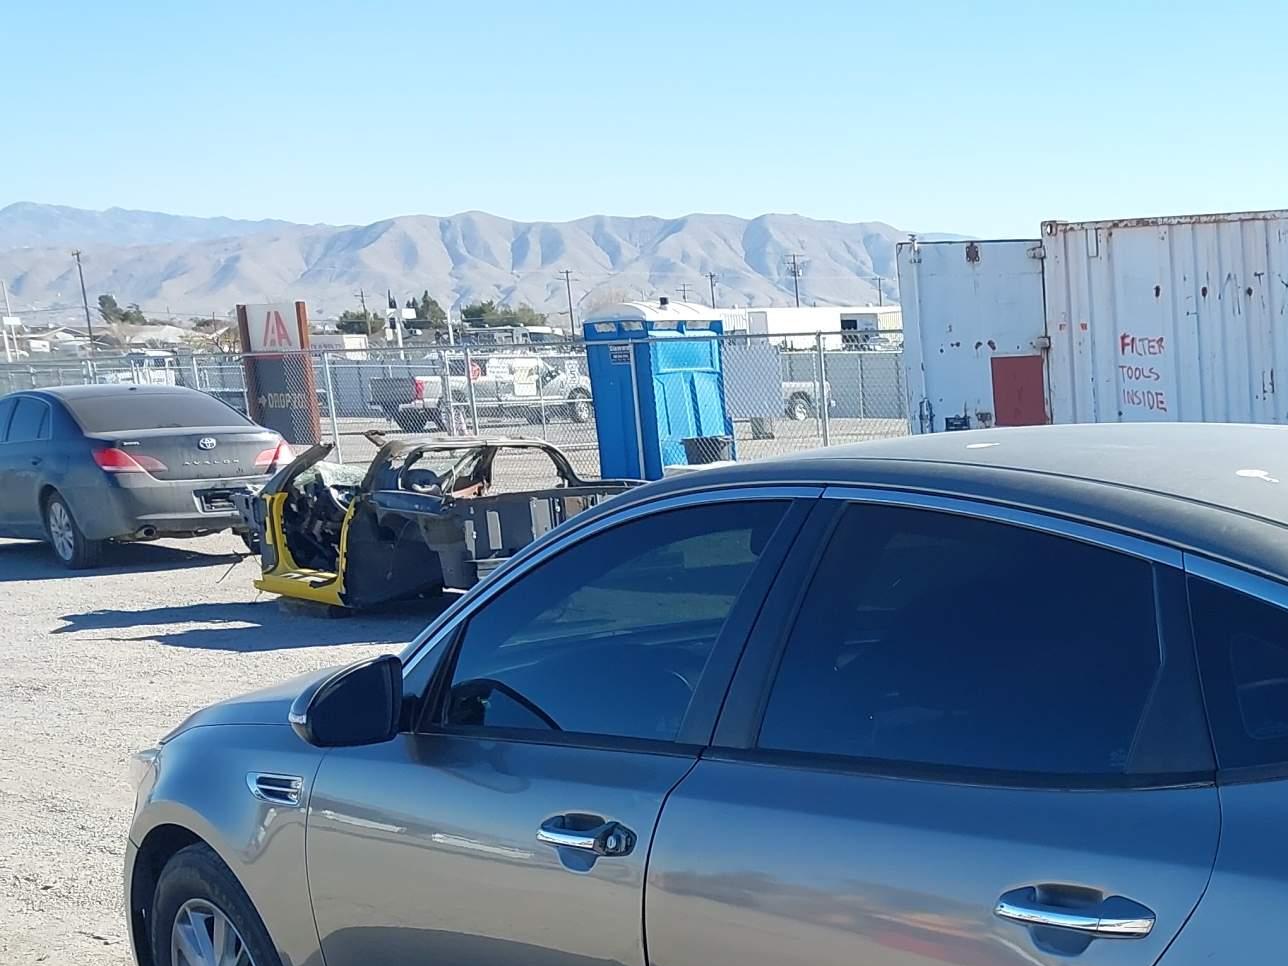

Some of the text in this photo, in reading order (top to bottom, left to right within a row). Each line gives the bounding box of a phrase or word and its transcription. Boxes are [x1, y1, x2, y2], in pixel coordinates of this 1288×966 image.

[1120, 333, 1165, 356] FILTER
[1119, 365, 1160, 384] TOOLS
[1123, 388, 1167, 412] INSIDE
